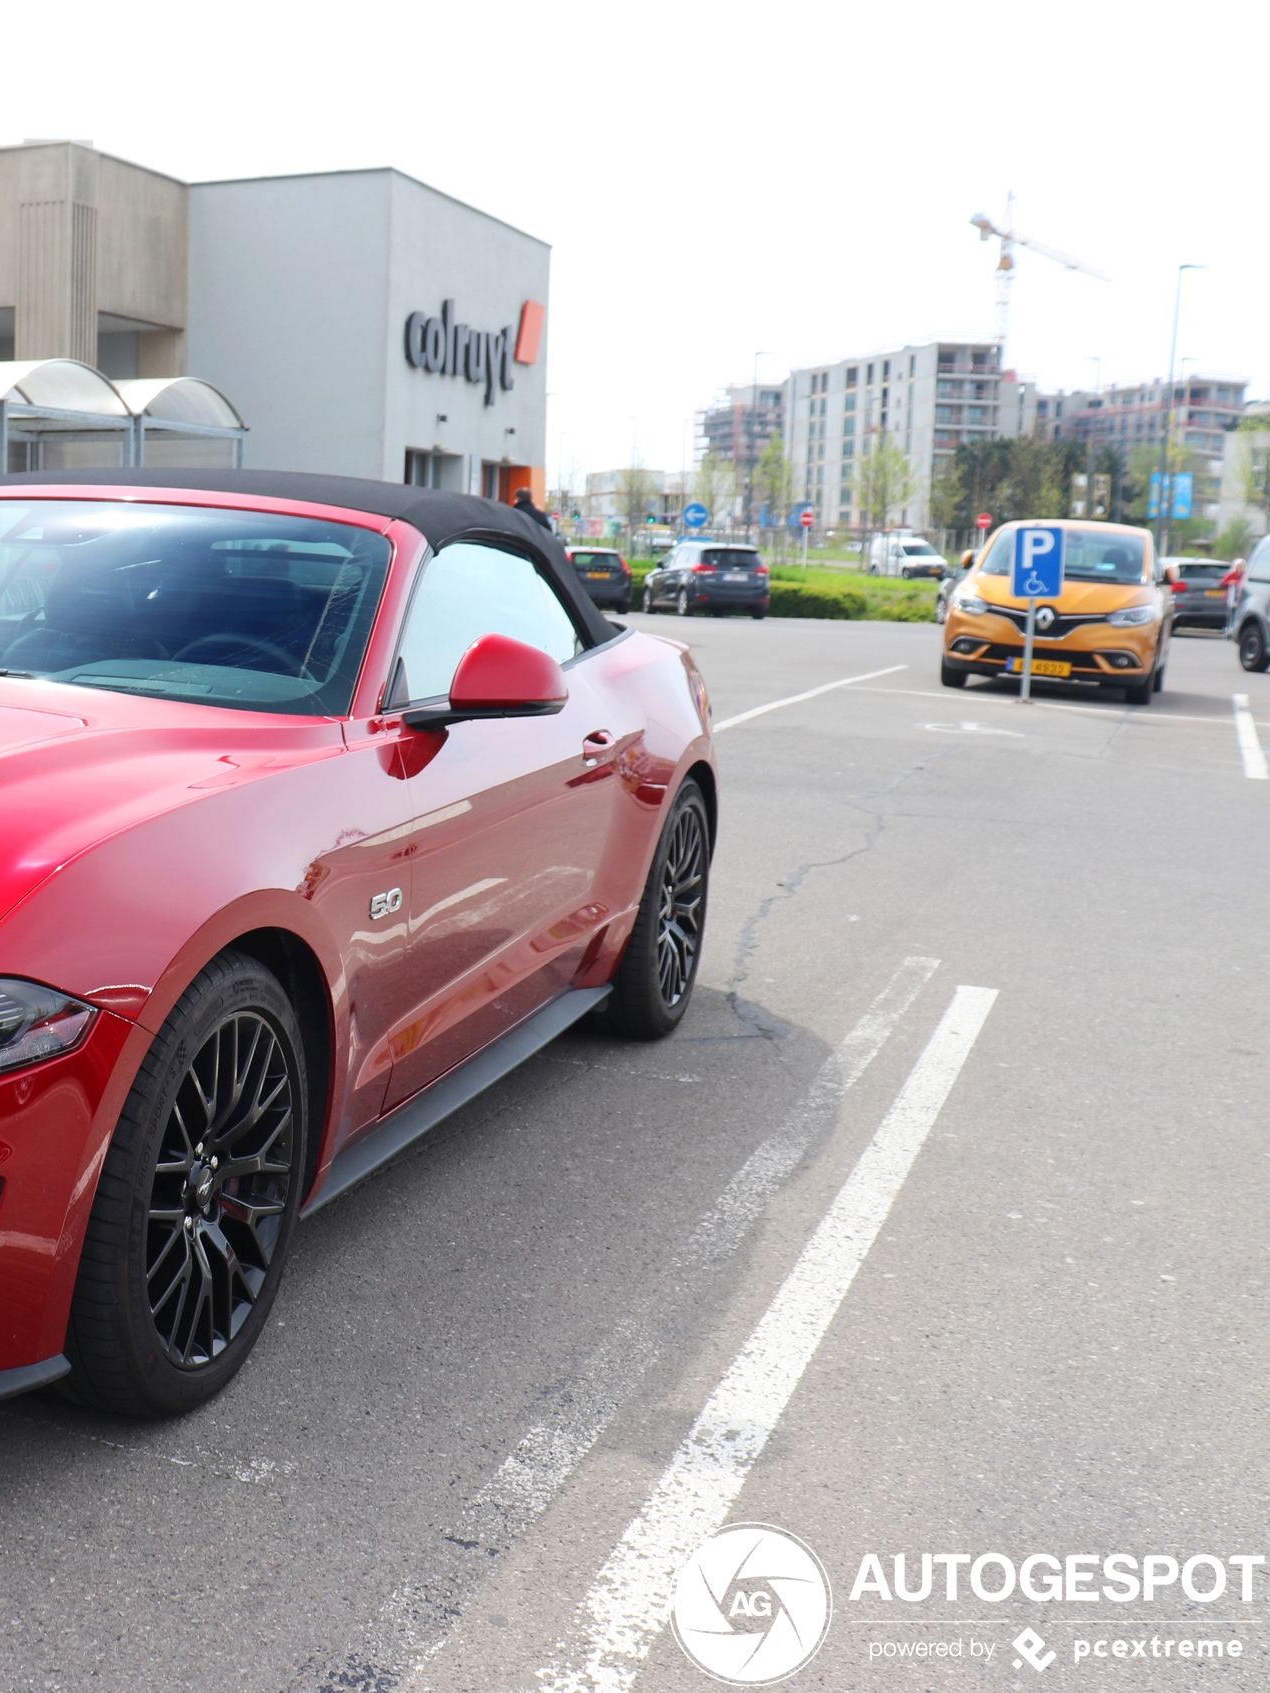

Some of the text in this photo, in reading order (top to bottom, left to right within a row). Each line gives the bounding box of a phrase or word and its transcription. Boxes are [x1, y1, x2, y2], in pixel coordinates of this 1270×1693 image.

[404, 299, 514, 406] colruyt
[1022, 530, 1055, 568] P
[370, 887, 403, 920] 5.0
[138, 1144, 152, 1189] PILOT
[149, 1092, 169, 1139] SPORT
